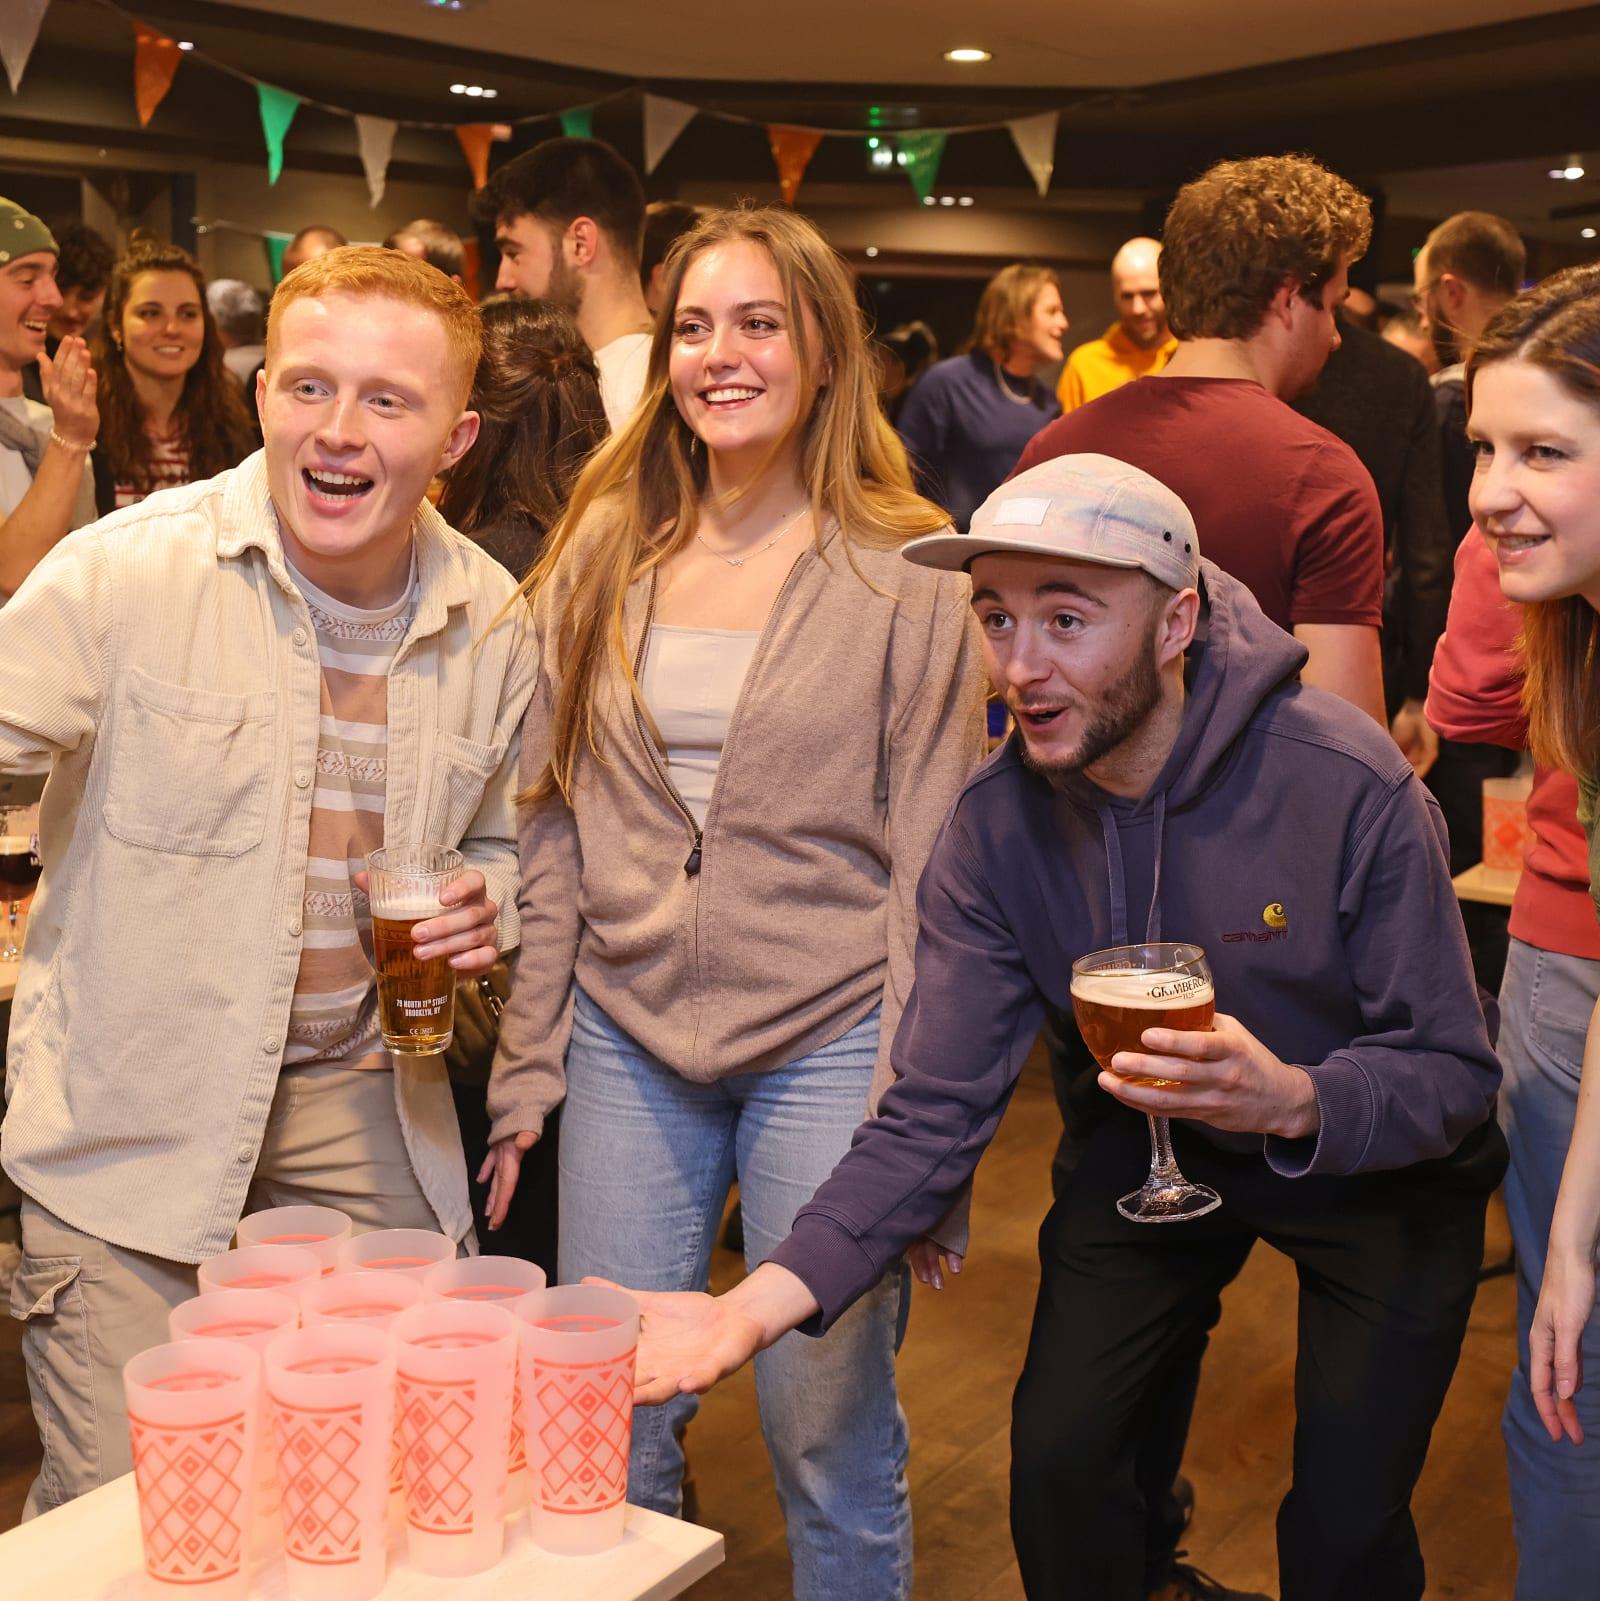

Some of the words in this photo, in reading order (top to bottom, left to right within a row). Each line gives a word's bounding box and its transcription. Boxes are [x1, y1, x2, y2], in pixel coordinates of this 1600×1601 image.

[403, 1000, 422, 1008] NORTH
[432, 994, 448, 1007] STREET
[433, 1006, 441, 1015] NY
